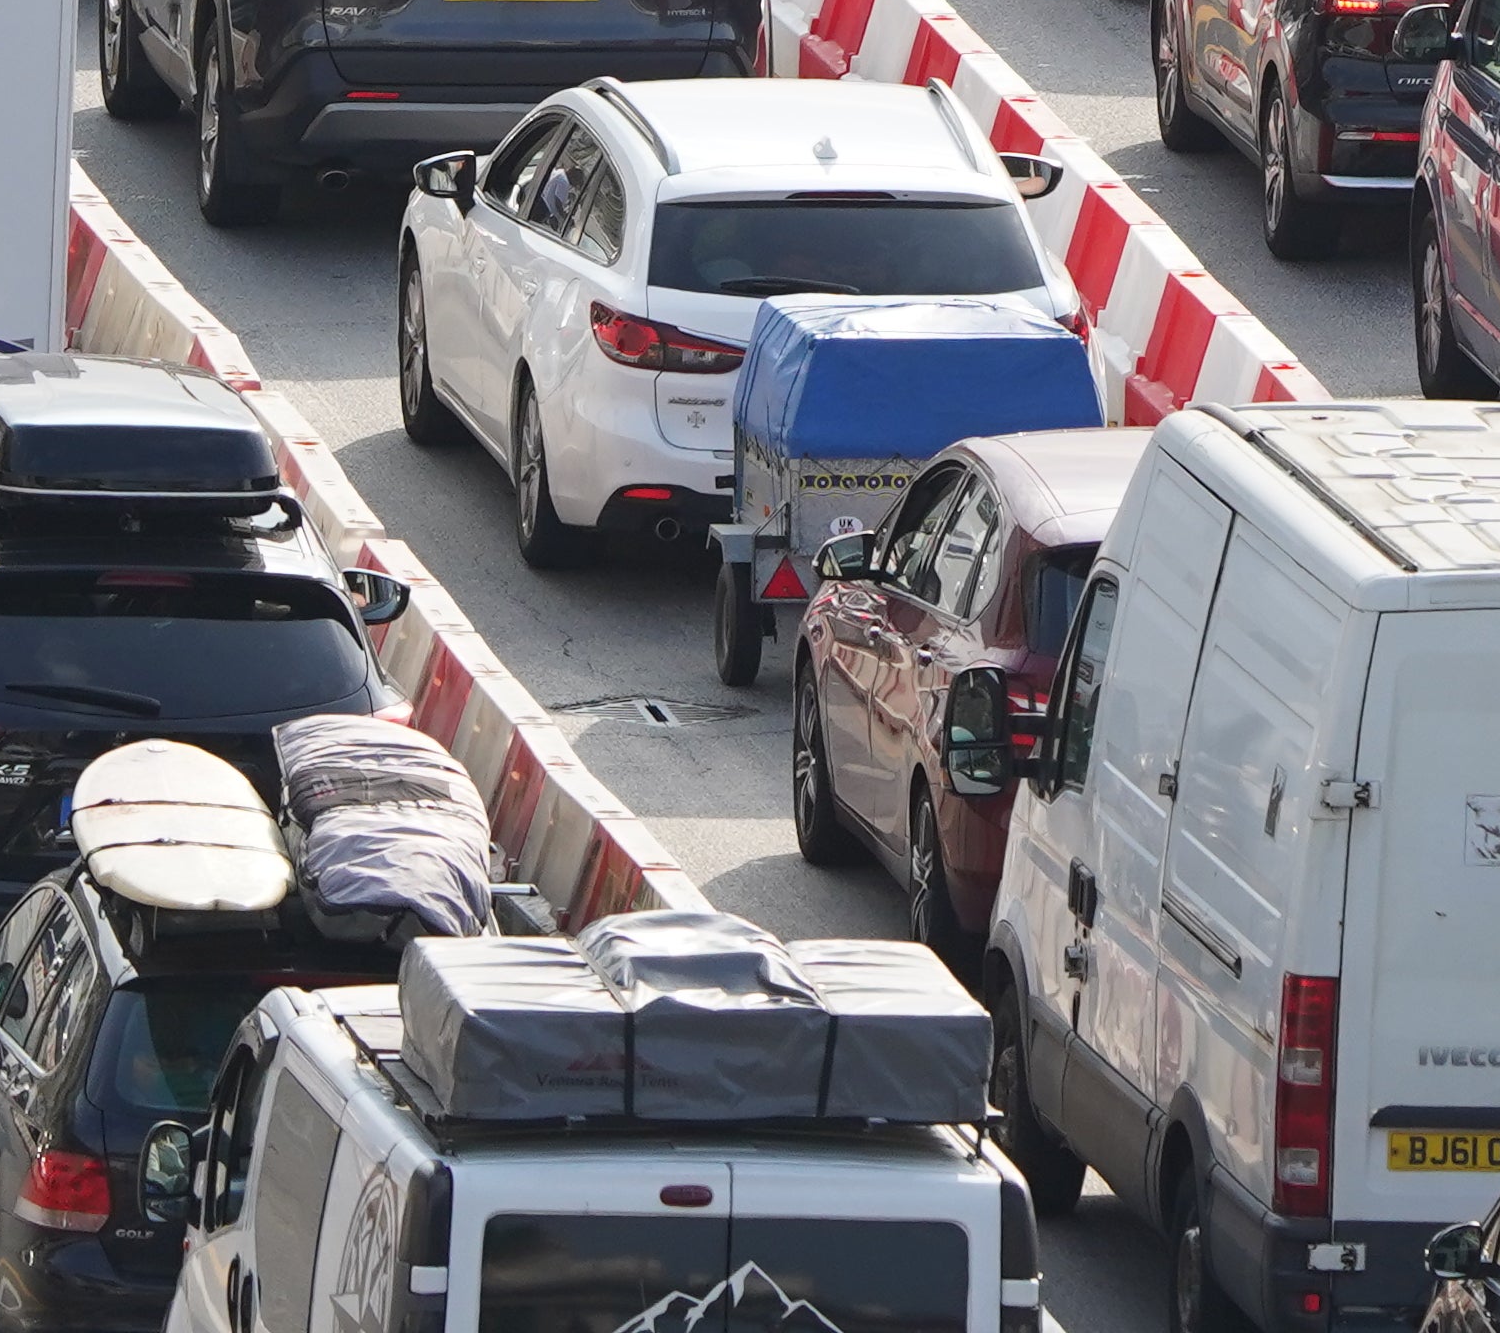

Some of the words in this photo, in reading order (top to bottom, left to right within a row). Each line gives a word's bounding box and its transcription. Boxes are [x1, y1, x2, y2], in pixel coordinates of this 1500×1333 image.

[839, 518, 853, 528] UK
[1409, 1136, 1479, 1166] BJ61
[114, 1228, 155, 1240] GOLF
